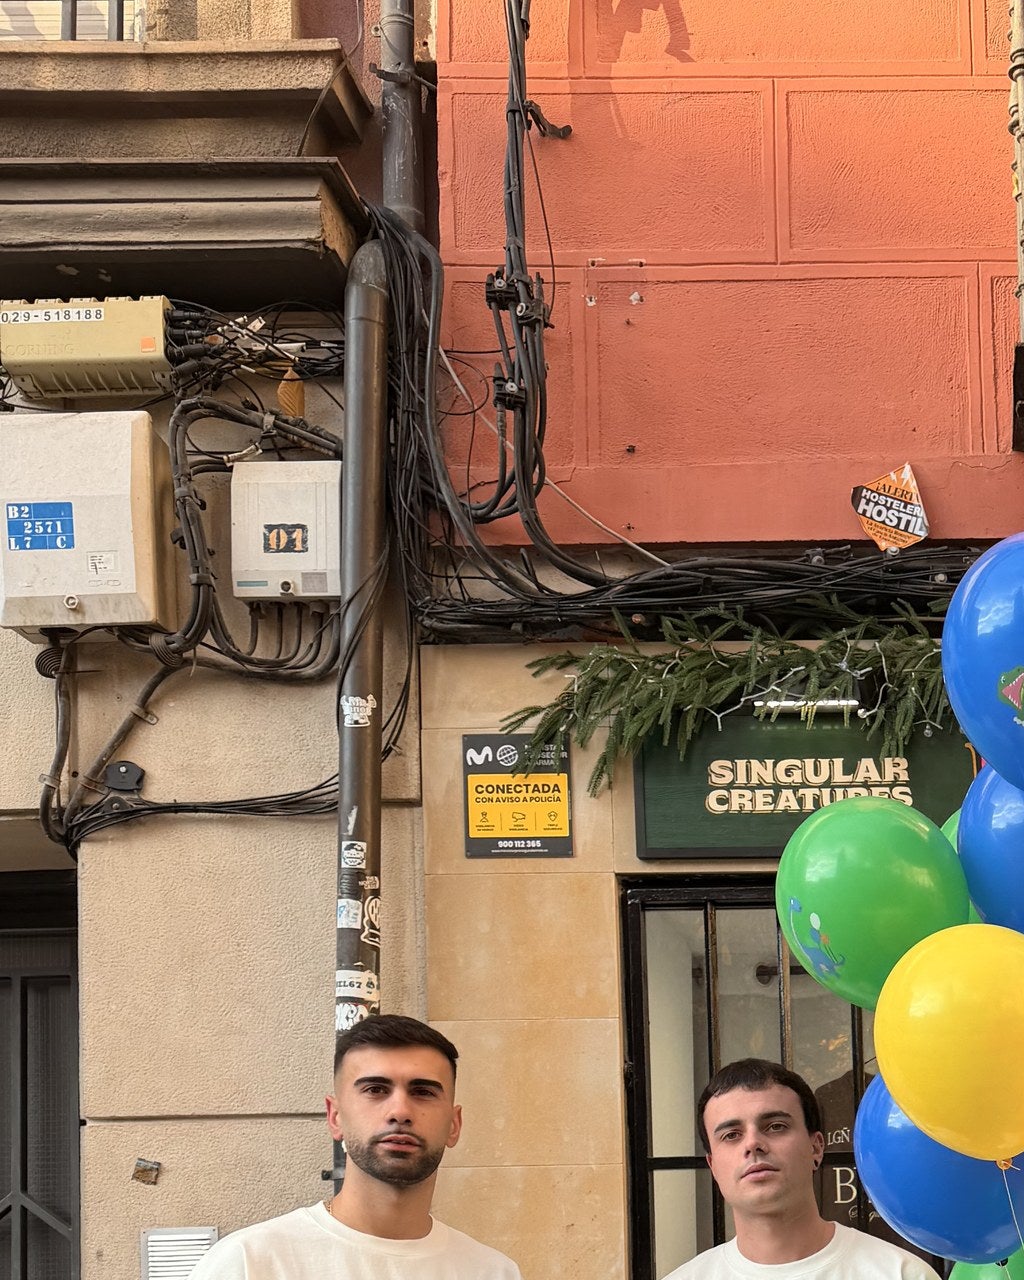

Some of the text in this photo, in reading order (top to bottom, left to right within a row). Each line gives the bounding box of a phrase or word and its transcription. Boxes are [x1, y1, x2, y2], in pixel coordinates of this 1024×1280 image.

[875, 482, 920, 503] ¡ALERT
[7, 506, 30, 518] B2
[857, 498, 927, 537] HOSTIL
[23, 521, 63, 533] 2571
[56, 536, 67, 548] C
[268, 528, 303, 551] 01
[708, 757, 910, 787] SINGULAR
[475, 783, 561, 795] CONECTADA
[475, 796, 494, 804] CON
[529, 793, 562, 803] POLICÍA
[827, 1126, 851, 1146] LGÑ
